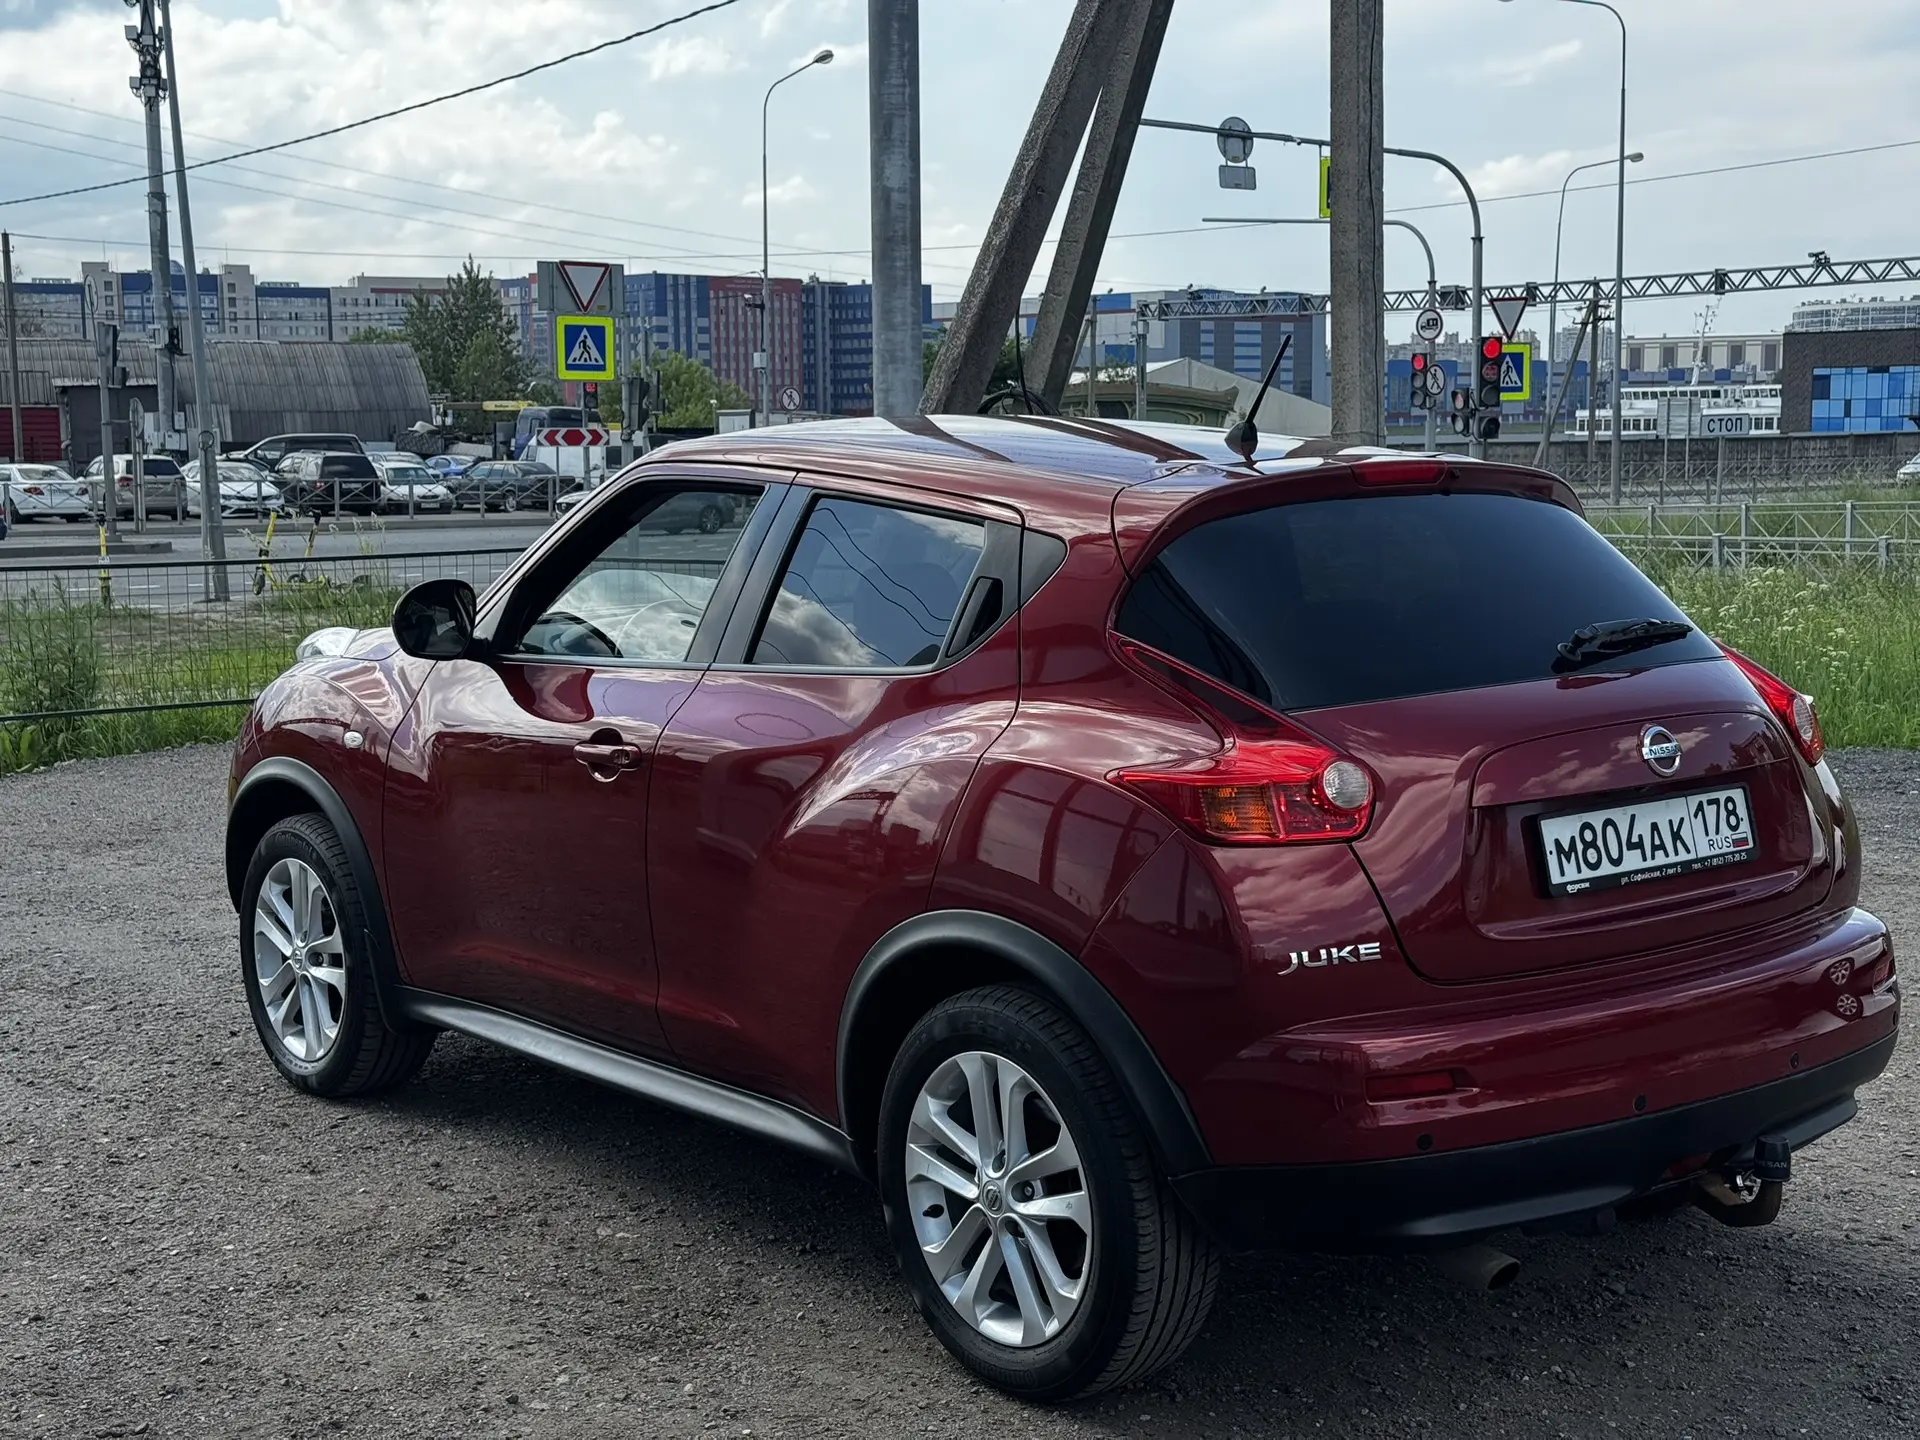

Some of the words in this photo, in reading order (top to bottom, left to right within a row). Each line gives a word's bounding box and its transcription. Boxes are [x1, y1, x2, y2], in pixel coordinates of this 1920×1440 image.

[1707, 417, 1743, 433] СТОП
[1554, 813, 1691, 877] М804АК
[1693, 795, 1741, 837] 178
[1708, 837, 1732, 851] RUS
[1277, 942, 1382, 976] JUKE
